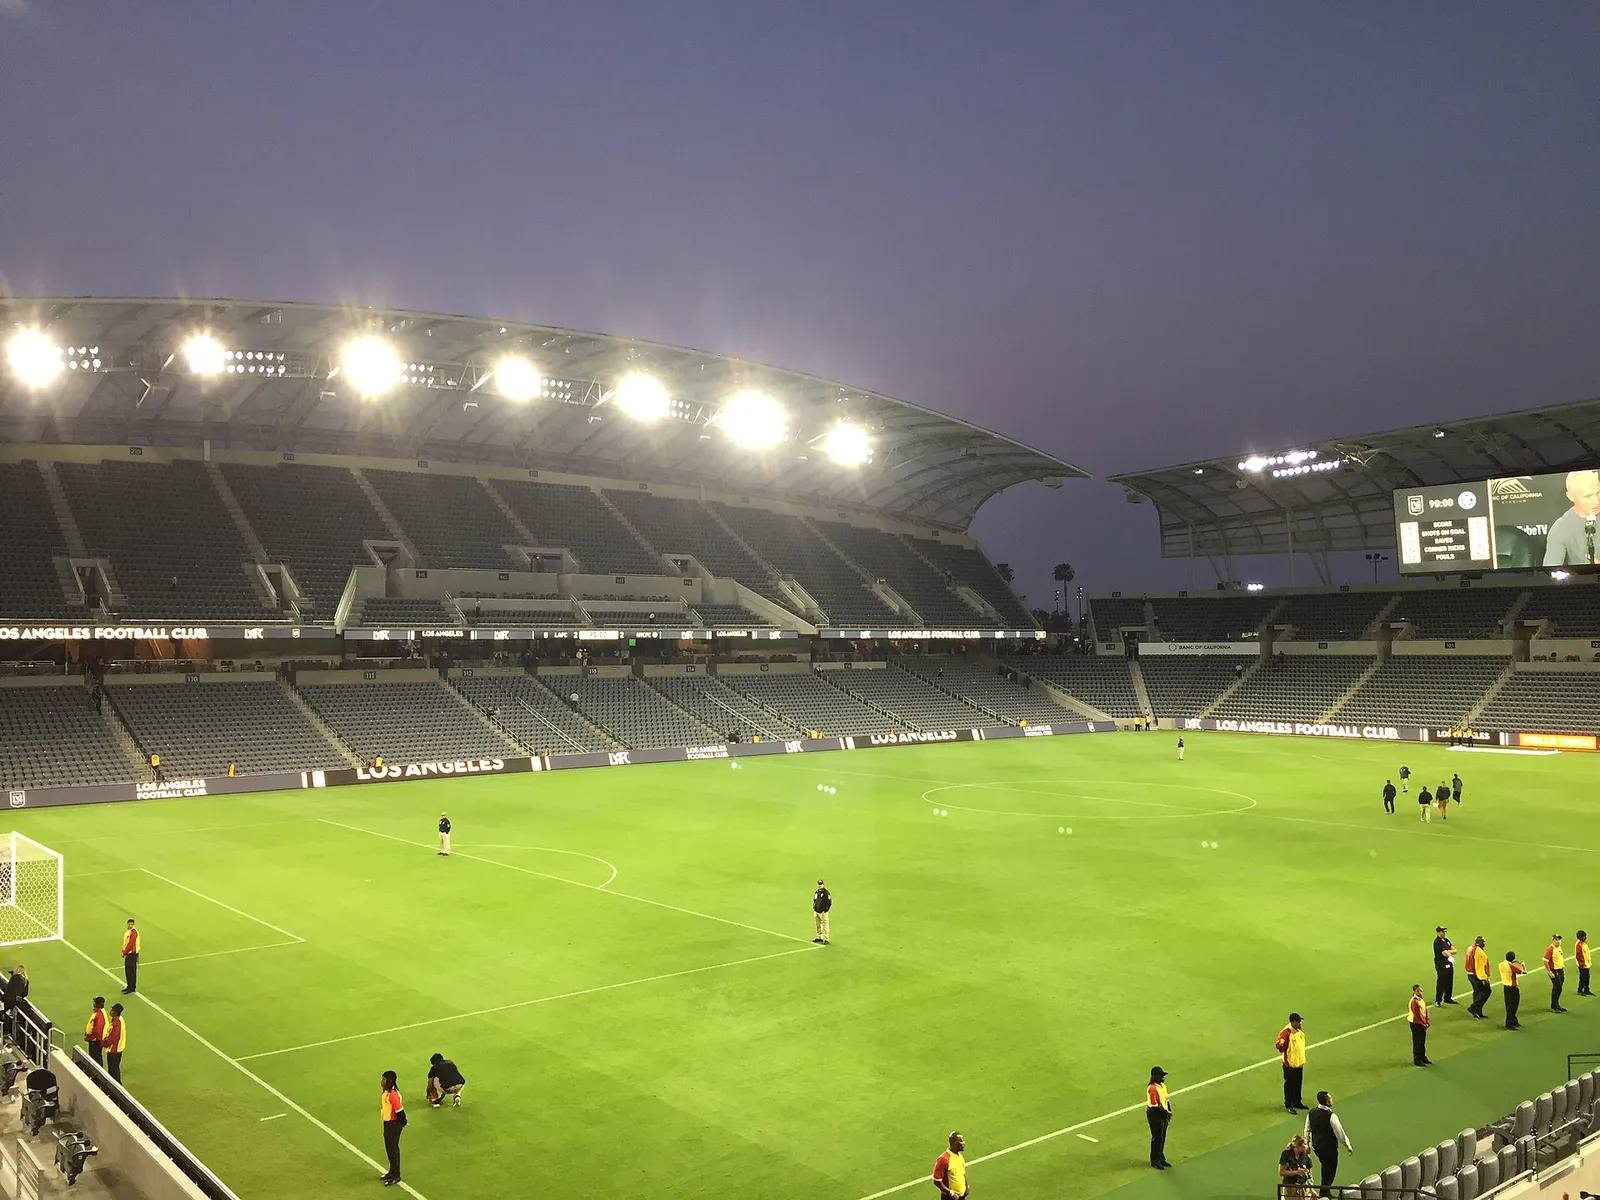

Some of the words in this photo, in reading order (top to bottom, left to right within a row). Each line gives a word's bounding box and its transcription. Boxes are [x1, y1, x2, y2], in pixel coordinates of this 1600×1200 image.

[1429, 498, 1454, 508] 90:00
[0, 628, 20, 639] OS
[21, 628, 91, 640] ANGELES
[95, 628, 169, 640] FOOTBALL
[888, 631, 901, 639] LOS
[902, 631, 931, 639] ANGELES
[932, 631, 963, 639] FOOTBALL
[1216, 719, 1238, 731] LOS
[1238, 721, 1292, 734] ANGELES
[1295, 723, 1361, 737] FOOTBALL
[870, 734, 898, 745] LOS
[898, 730, 957, 743] ANGELES
[699, 745, 728, 753] ANGELES
[356, 765, 402, 780] LOS
[405, 759, 505, 777] ANGELES
[136, 783, 157, 792] LOS
[158, 780, 206, 790] ANGELES
[136, 790, 183, 800] FOOTBALL
